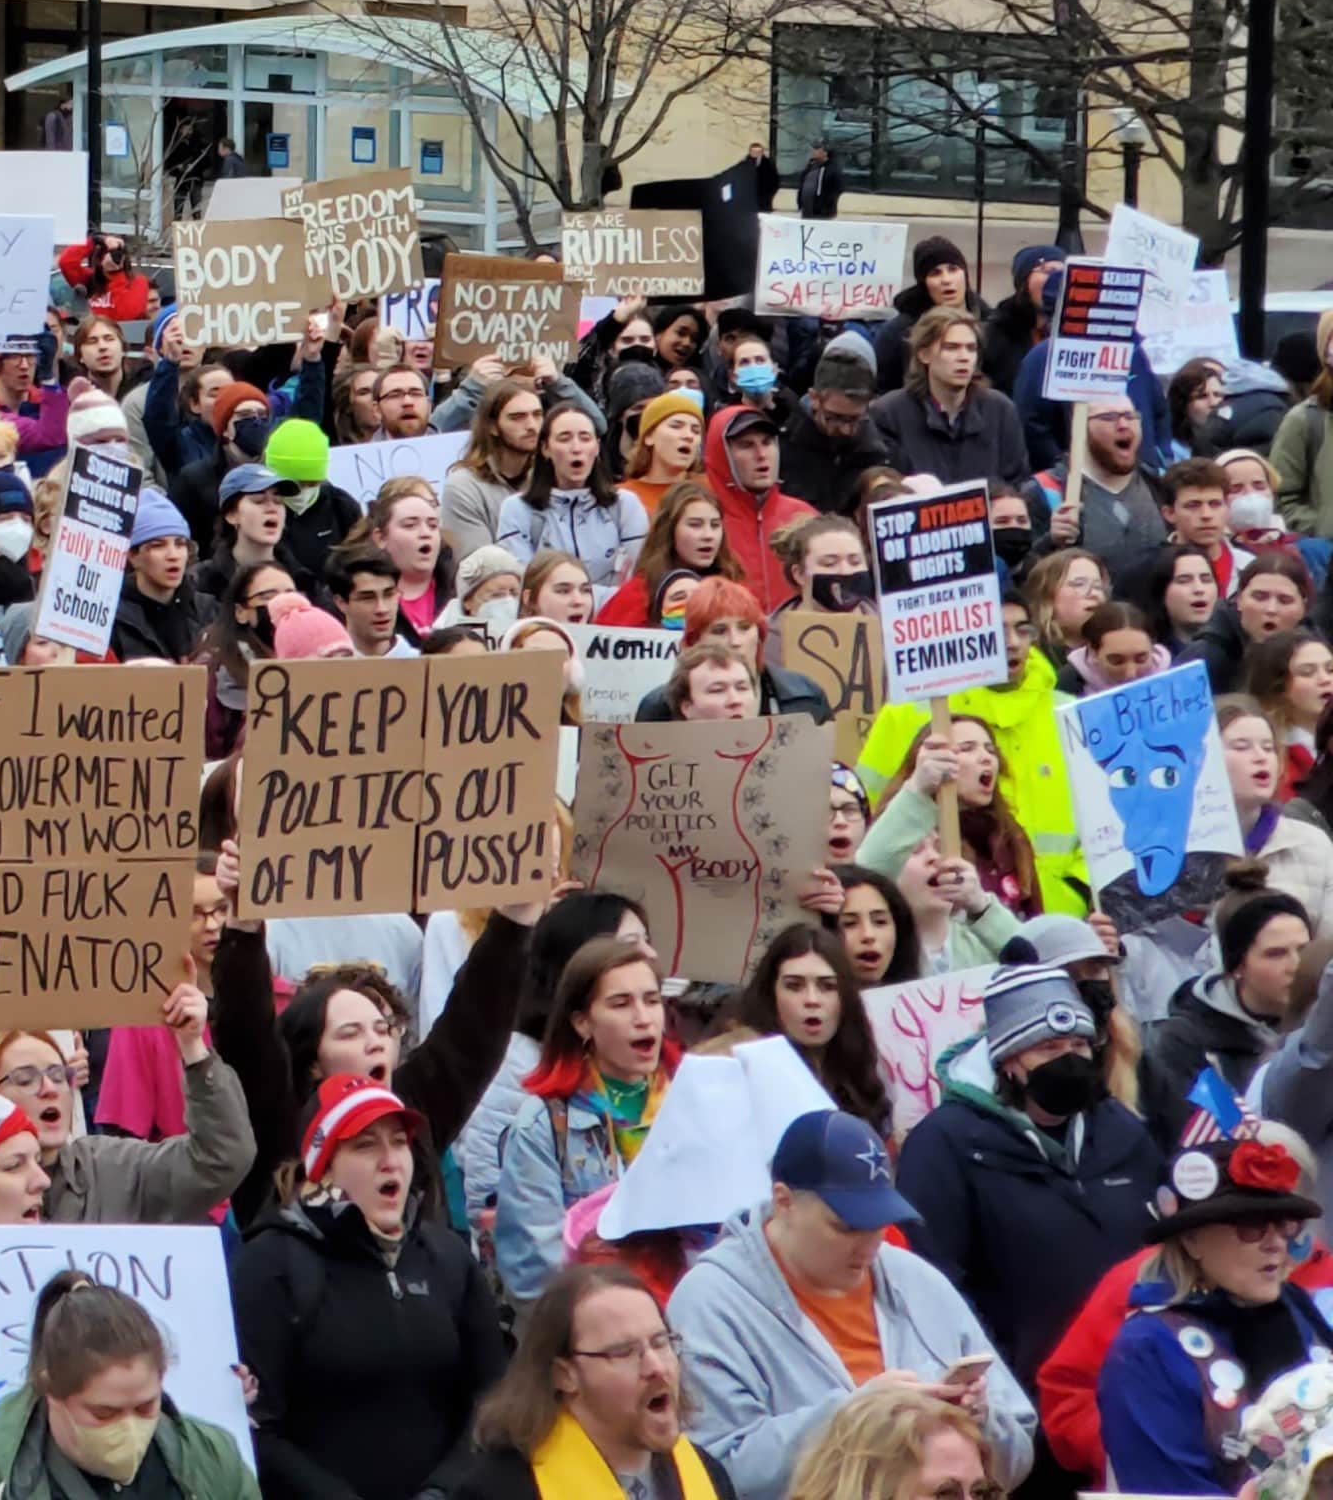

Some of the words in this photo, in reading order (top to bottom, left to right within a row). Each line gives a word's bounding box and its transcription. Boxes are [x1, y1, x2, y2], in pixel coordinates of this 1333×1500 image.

[176, 222, 206, 246] MY
[360, 214, 410, 238] WITH
[563, 214, 587, 228] WE
[593, 213, 626, 228] ARE
[562, 226, 701, 267] RUTHLESS
[800, 224, 864, 262] Keep
[177, 244, 283, 289] BODY
[768, 259, 877, 277] ABORTION
[180, 289, 202, 303] MY
[179, 301, 305, 348] CHOICE
[1057, 349, 1096, 368] FIGHT
[1098, 346, 1131, 370] ALL
[354, 444, 424, 487] NO
[876, 510, 916, 538] STOP
[919, 496, 985, 530] ATTACKS
[58, 525, 94, 561] Fully
[883, 538, 906, 562] ON
[910, 522, 986, 557] ABORTION
[76, 564, 102, 593] Our
[910, 551, 966, 583] RIGHTS
[53, 586, 110, 628] Schools
[897, 594, 925, 613] FIGHT
[928, 589, 955, 607] BACK
[959, 583, 984, 601] WITH
[892, 601, 995, 645] SOCIALIST
[895, 631, 998, 676] FEMINISM
[20, 669, 45, 737] I
[57, 681, 185, 744] wanted
[279, 685, 407, 757] KEEP
[437, 681, 541, 747] YOUR
[1062, 709, 1102, 755] No
[1112, 674, 1209, 737] Bitches?
[647, 762, 700, 791] GET
[256, 769, 444, 838] POLITICS
[455, 762, 525, 822] OUT
[640, 791, 704, 811] YOUR
[25, 817, 70, 858] MY
[81, 810, 197, 855] WOMB
[625, 813, 717, 831] POLITICS
[250, 854, 295, 906] OF
[305, 843, 374, 902] MY
[419, 821, 547, 897] PUSSY!
[689, 857, 759, 883] BODY
[42, 869, 130, 922] FUCK
[148, 872, 177, 919] A
